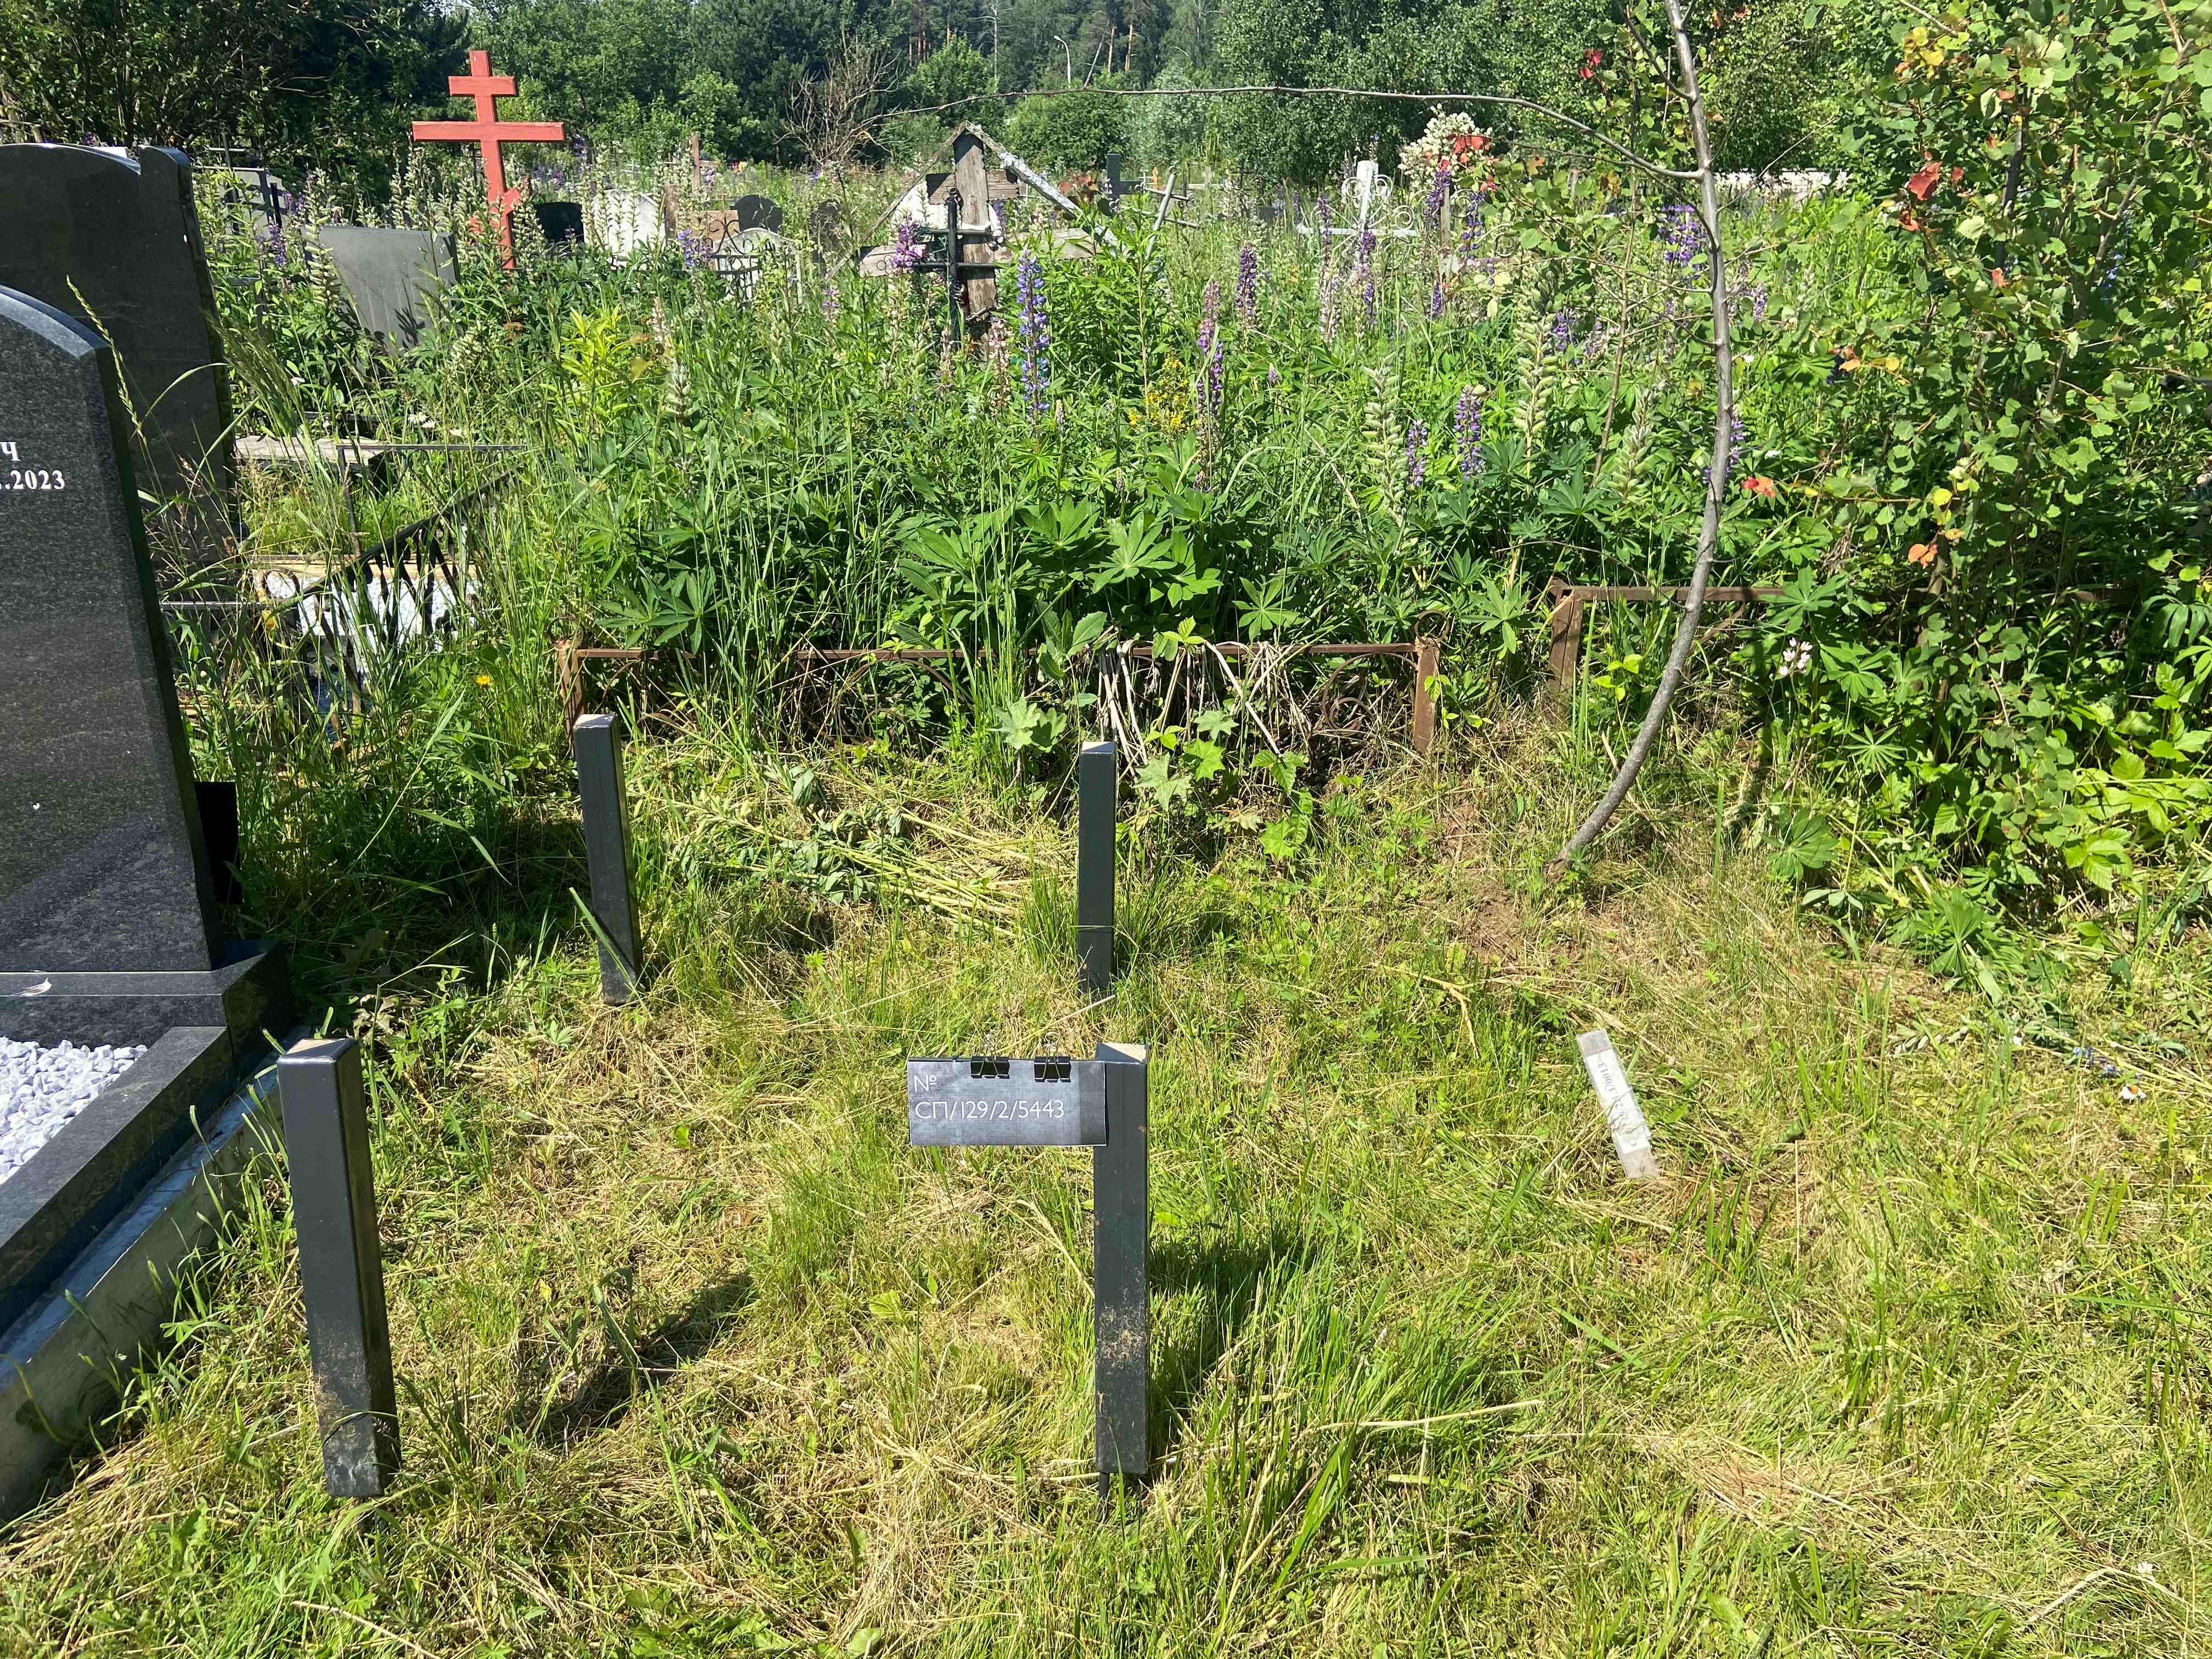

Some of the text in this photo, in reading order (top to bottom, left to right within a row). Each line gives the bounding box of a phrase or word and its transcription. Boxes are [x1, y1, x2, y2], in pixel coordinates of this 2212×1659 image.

[0, 470, 65, 490] .2023
[913, 1074, 938, 1092] №
[915, 1099, 1065, 1121] СП/129/2/5443
